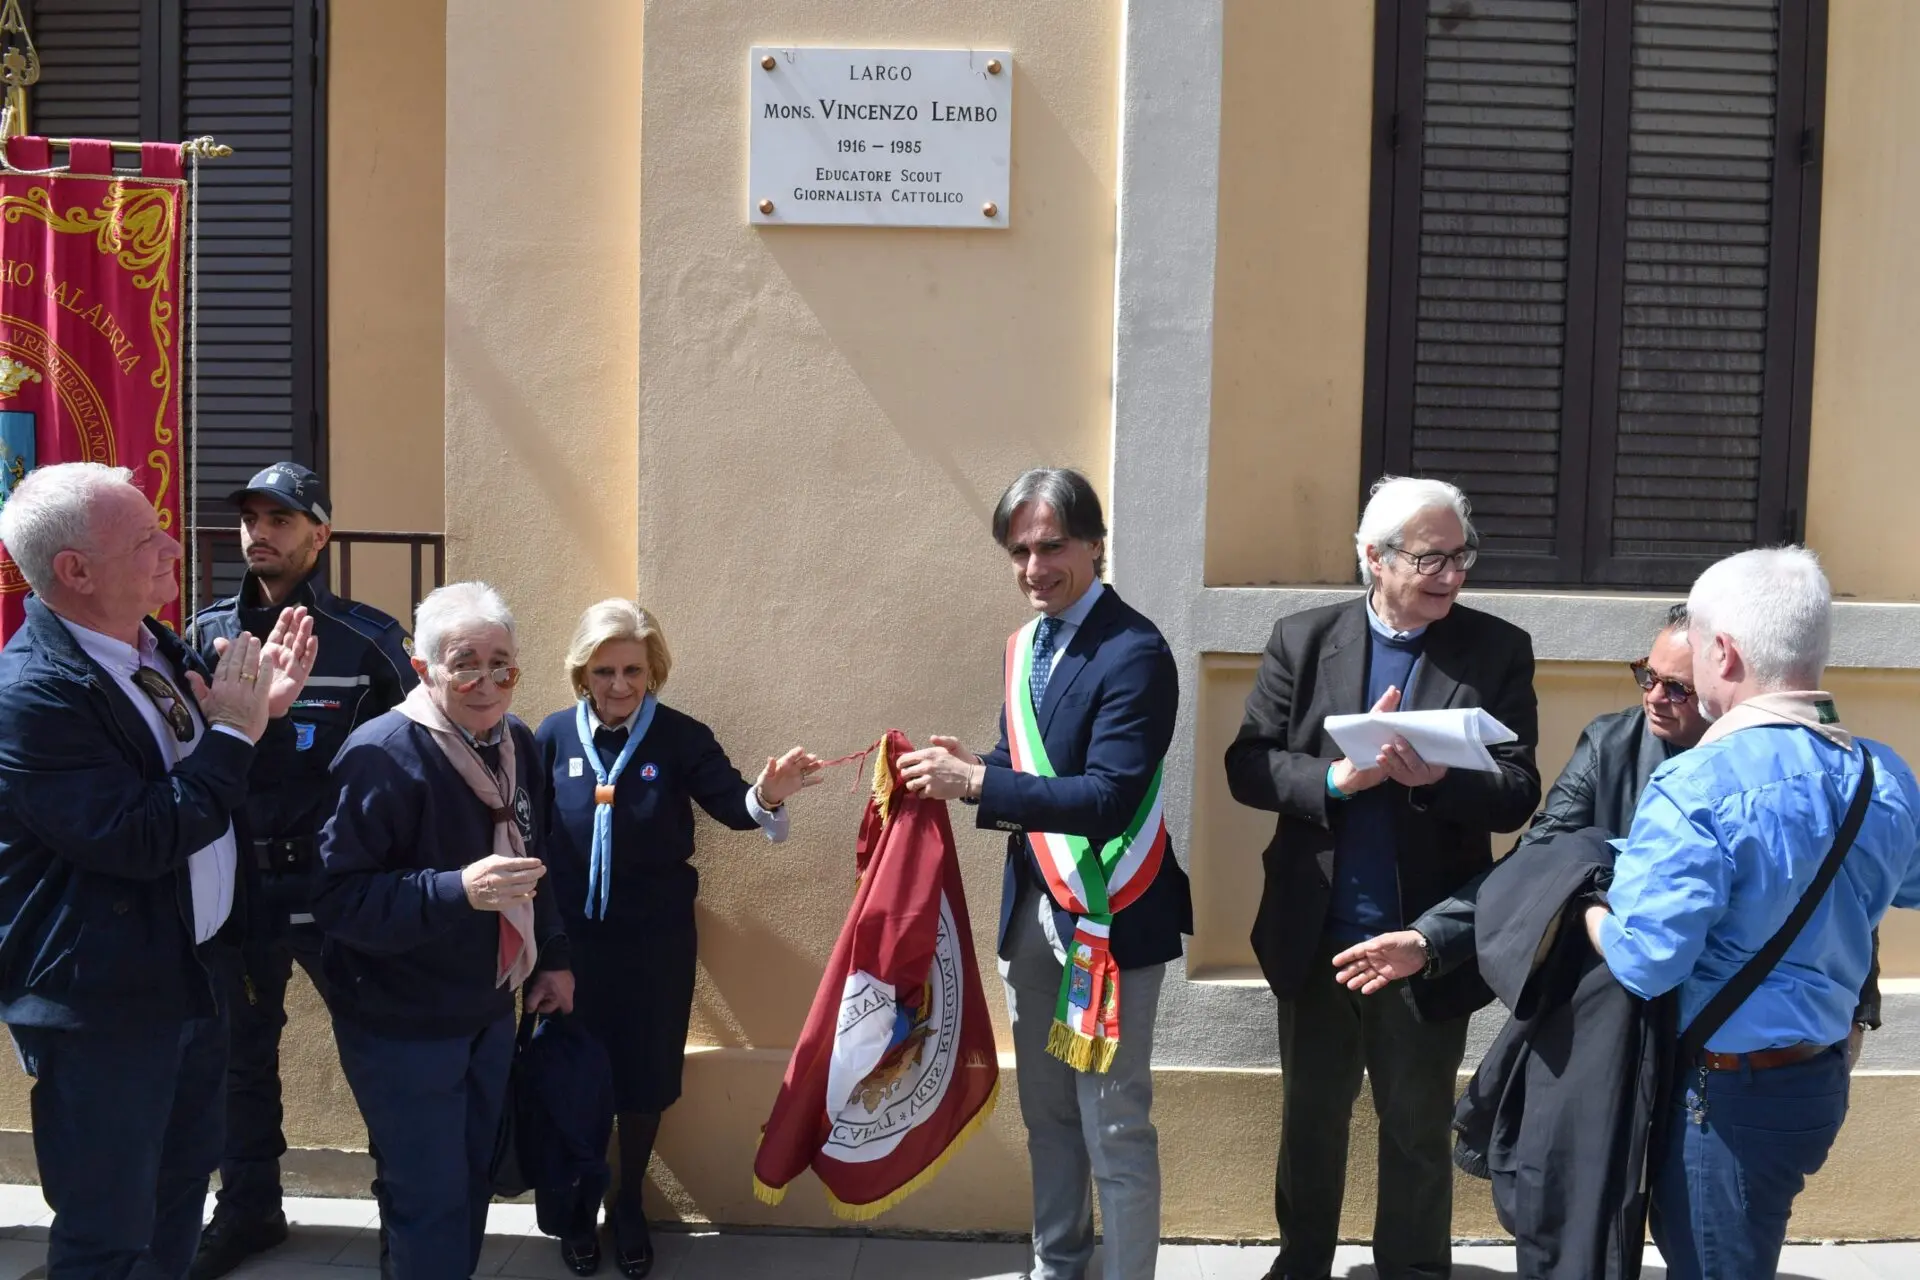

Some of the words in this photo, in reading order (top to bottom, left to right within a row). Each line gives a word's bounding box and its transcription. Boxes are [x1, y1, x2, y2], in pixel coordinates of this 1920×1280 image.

[849, 65, 913, 82] LARGO
[763, 102, 816, 120] MONS.
[818, 99, 919, 122] VINCENZO
[931, 101, 998, 123] LEMBO
[836, 139, 867, 153] 1916
[890, 140, 923, 154] 1985
[815, 167, 893, 183] EDUCATORE
[900, 169, 943, 184] SCOUT
[793, 187, 883, 203] GIORNALISTA
[891, 189, 965, 204] CATTOLICO
